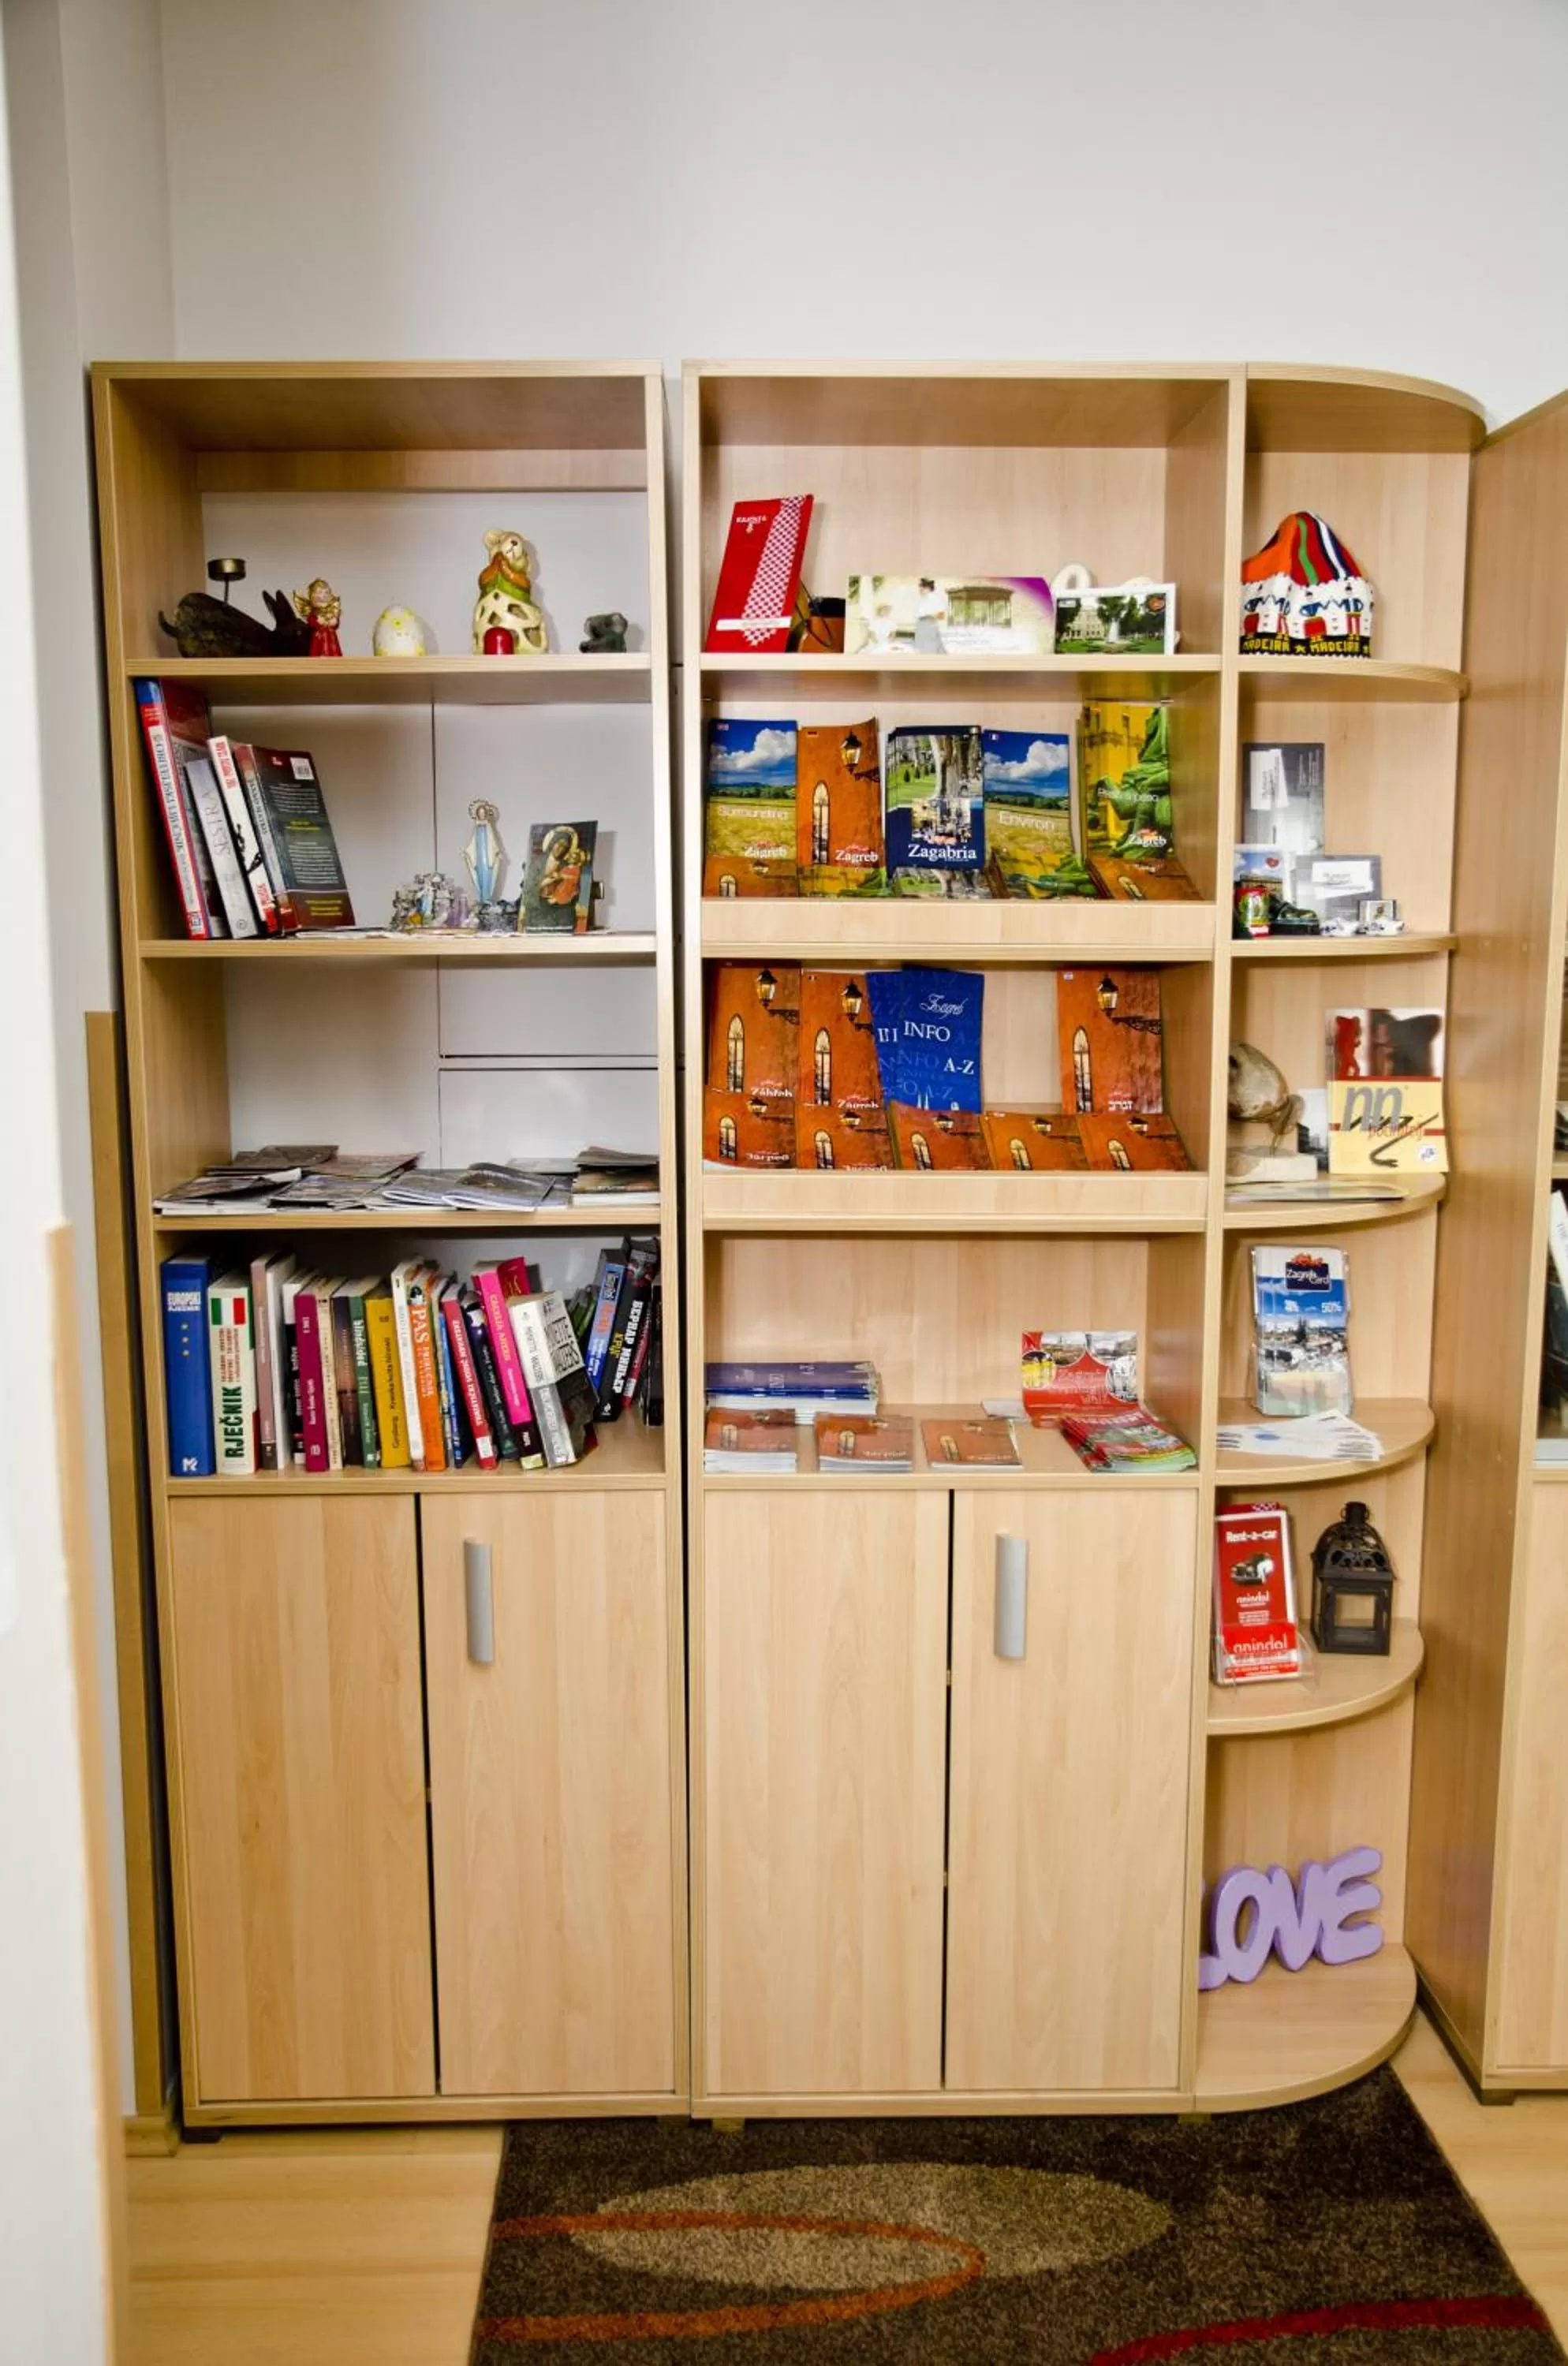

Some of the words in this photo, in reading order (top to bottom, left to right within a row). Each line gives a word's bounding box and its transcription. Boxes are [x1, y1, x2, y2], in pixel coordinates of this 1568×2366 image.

[202, 789, 230, 856] SESTRA
[835, 849, 879, 863] Zagreb
[908, 844, 977, 862] Zagabria
[903, 1020, 951, 1043] INFO
[943, 1057, 975, 1076] A-Z
[411, 1309, 430, 1344] PAS
[624, 1301, 644, 1345] БЕРНАР
[218, 1386, 245, 1458] RJEČNIK
